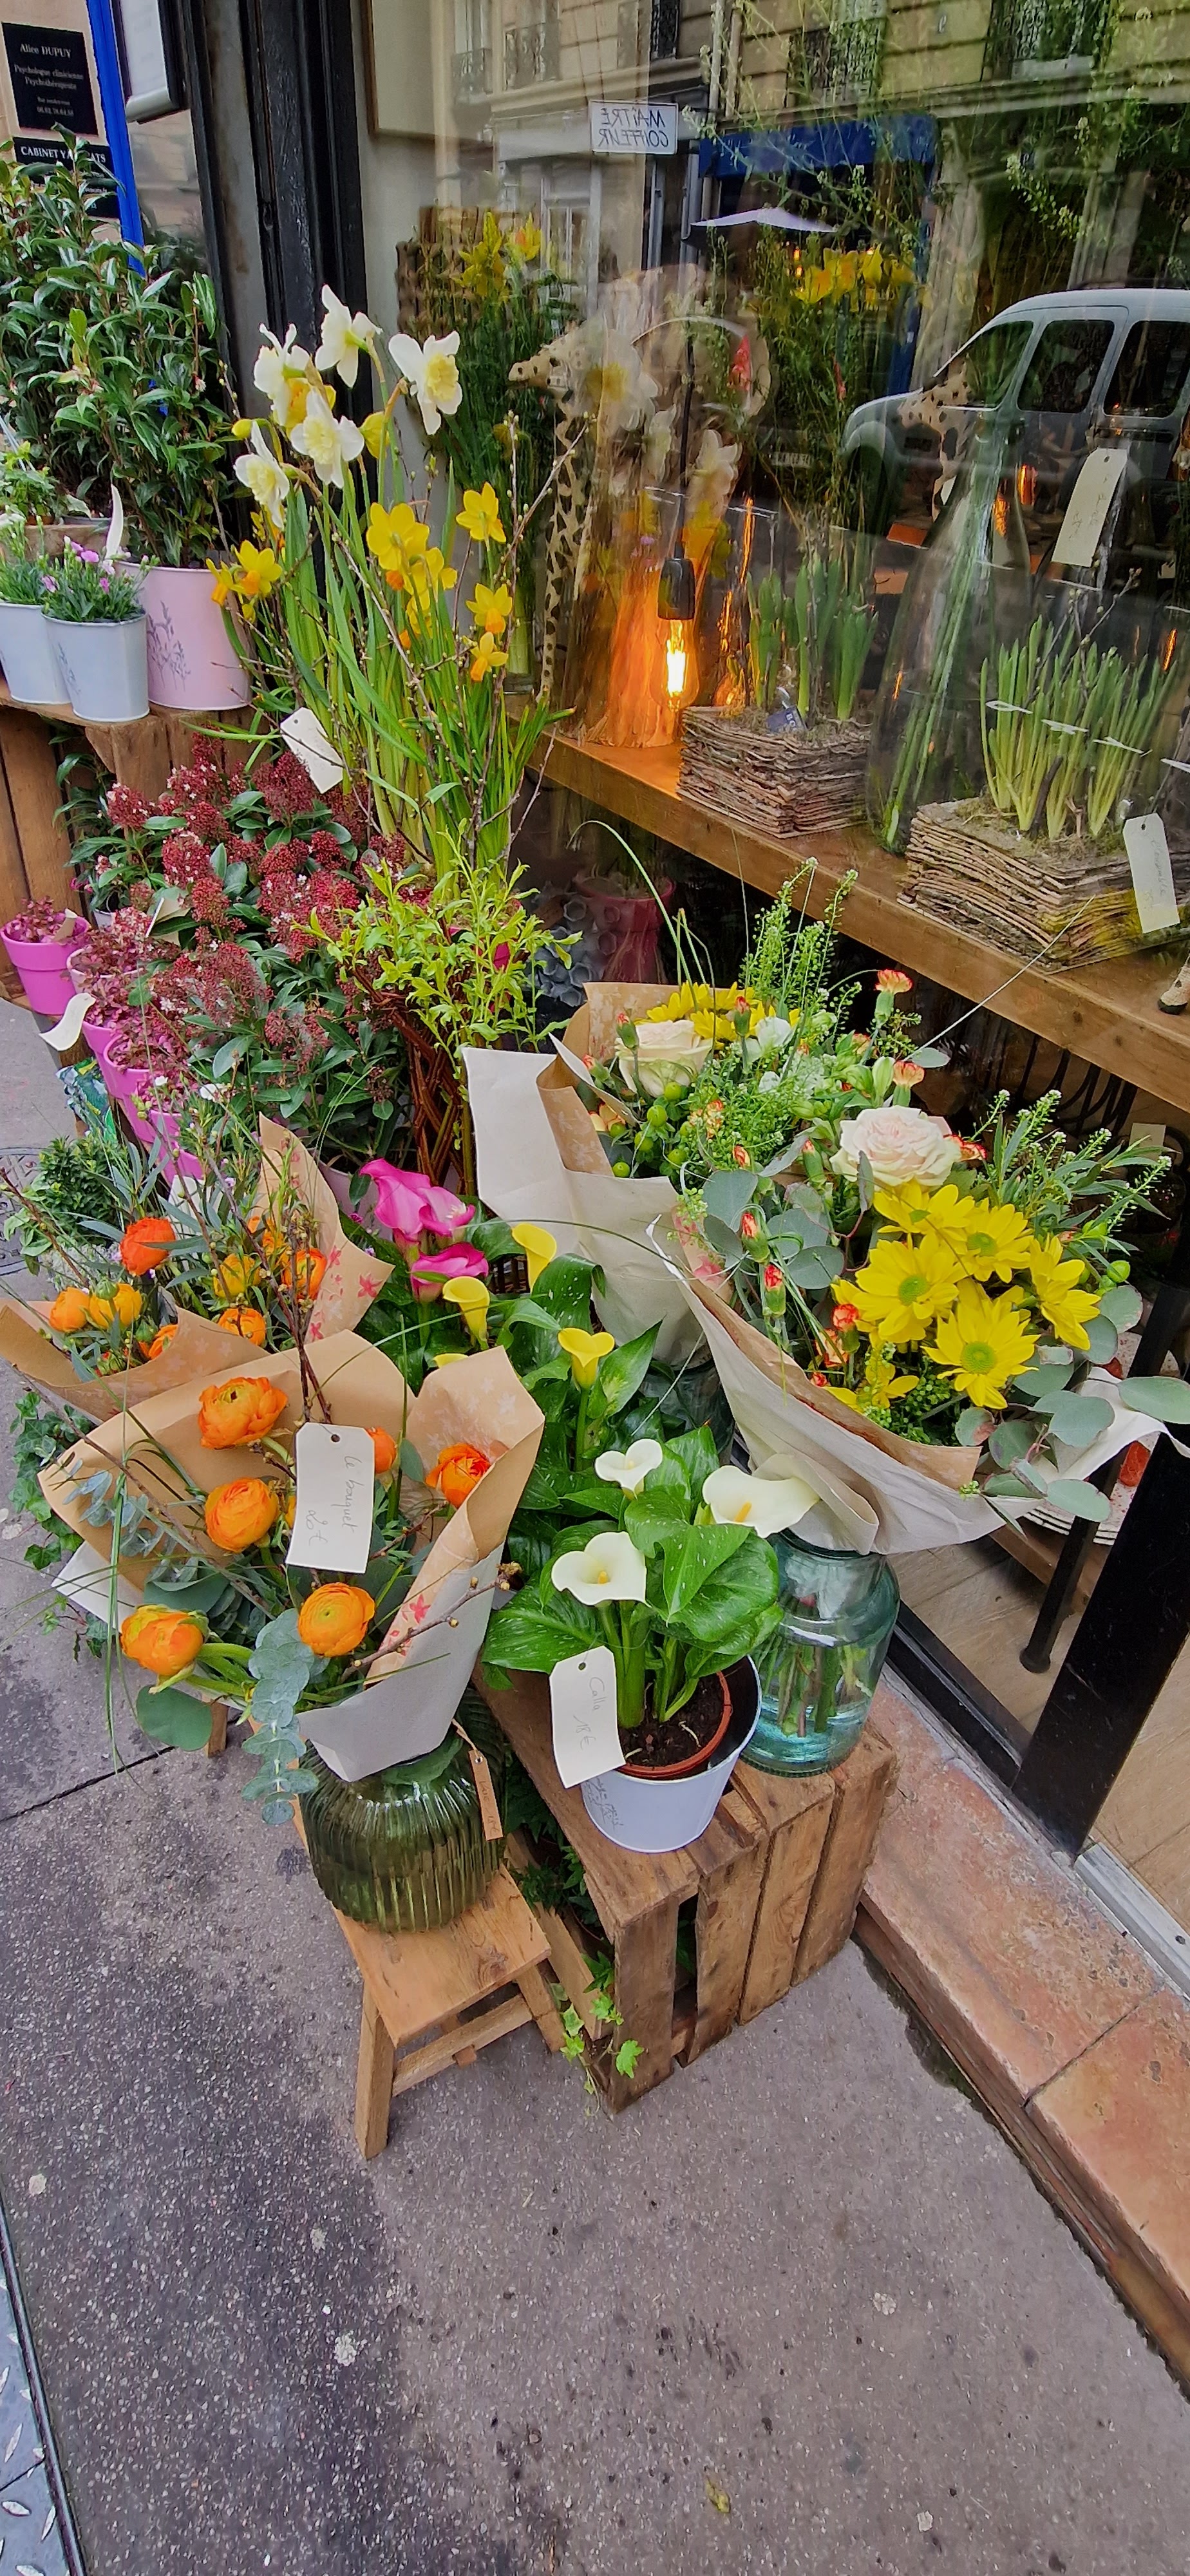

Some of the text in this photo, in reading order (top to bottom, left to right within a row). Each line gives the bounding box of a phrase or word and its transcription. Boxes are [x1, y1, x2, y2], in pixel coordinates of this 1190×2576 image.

[20, 43, 71, 59] Alice DUPUY
[21, 146, 58, 158] CABINET
[330, 1479, 364, 1533] bouquet
[589, 1676, 608, 1711] Calla
